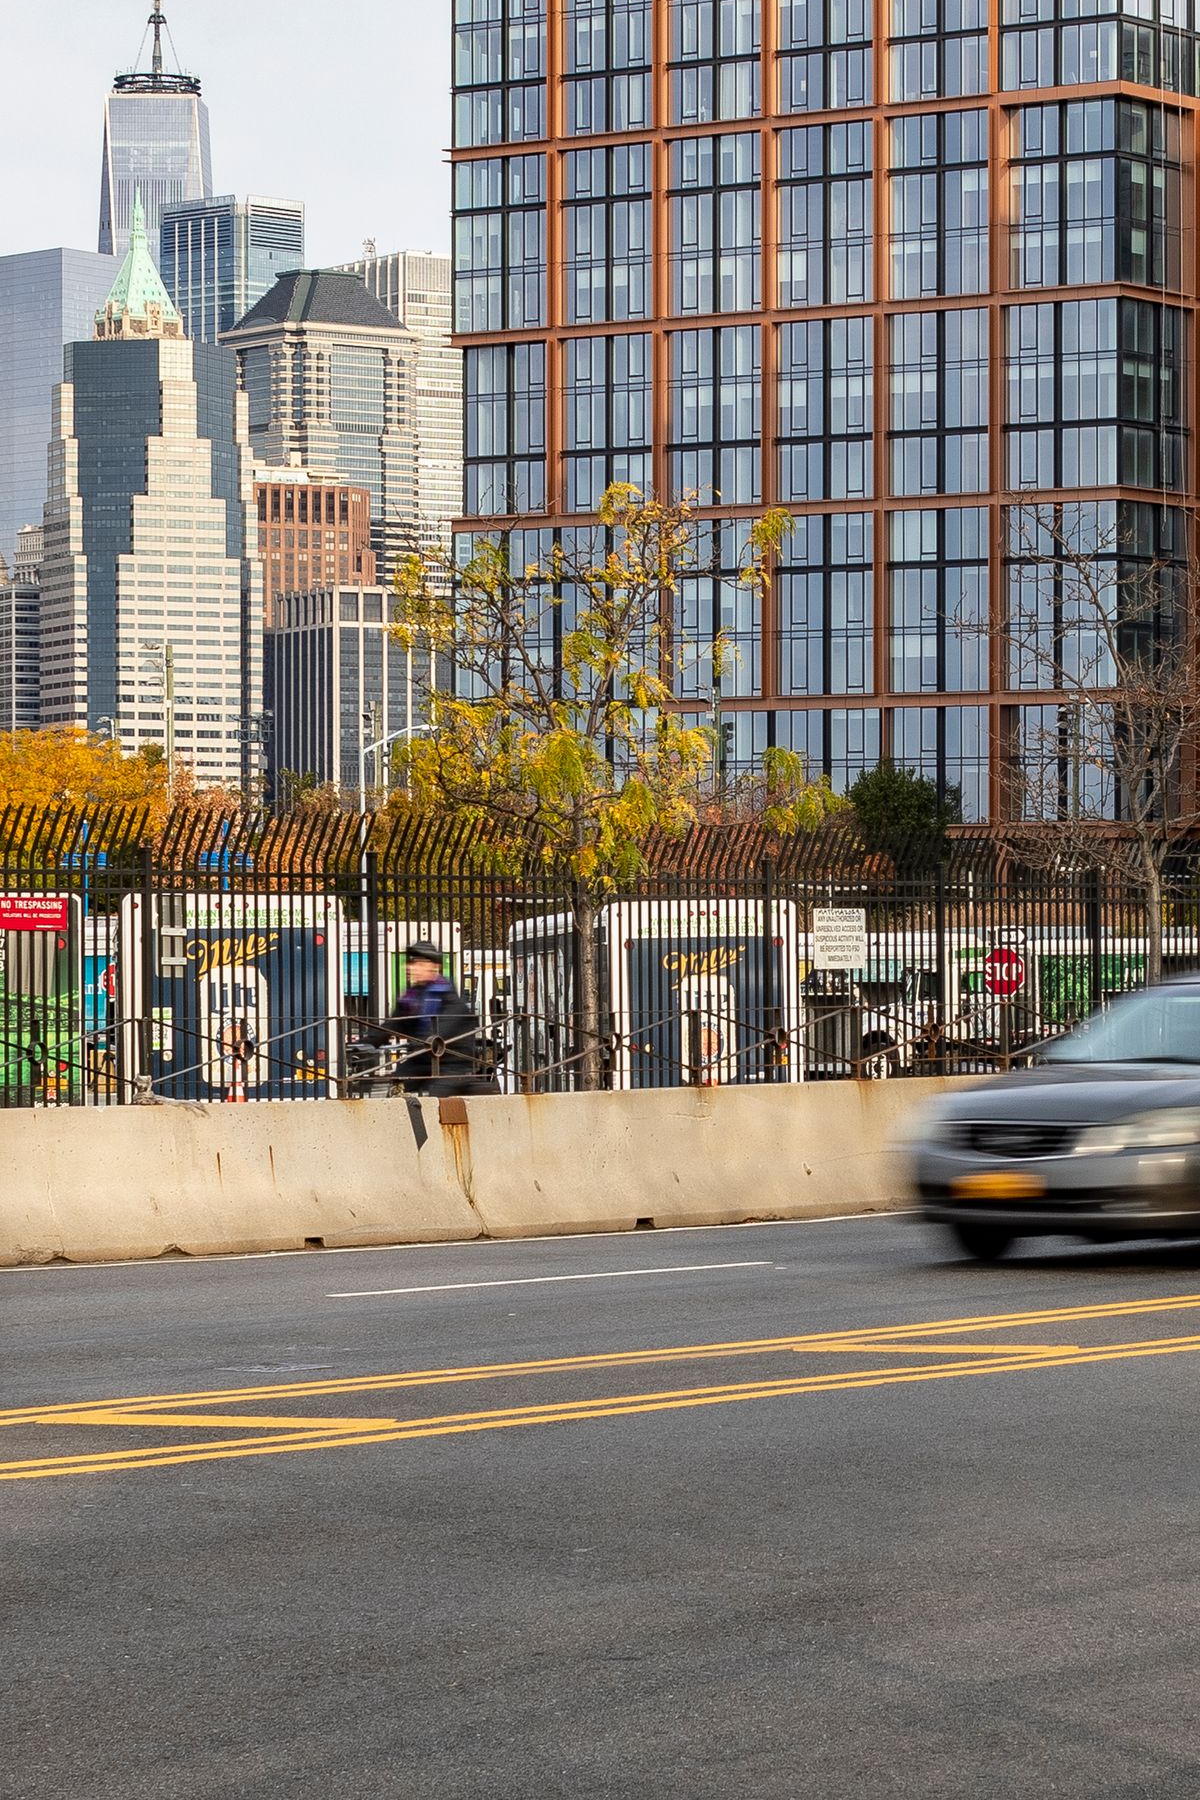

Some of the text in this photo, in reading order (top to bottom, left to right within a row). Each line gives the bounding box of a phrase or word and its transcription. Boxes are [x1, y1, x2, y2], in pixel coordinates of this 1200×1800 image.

[0, 900, 63, 911] NO TRESPASSING
[985, 962, 1022, 981] STOP
